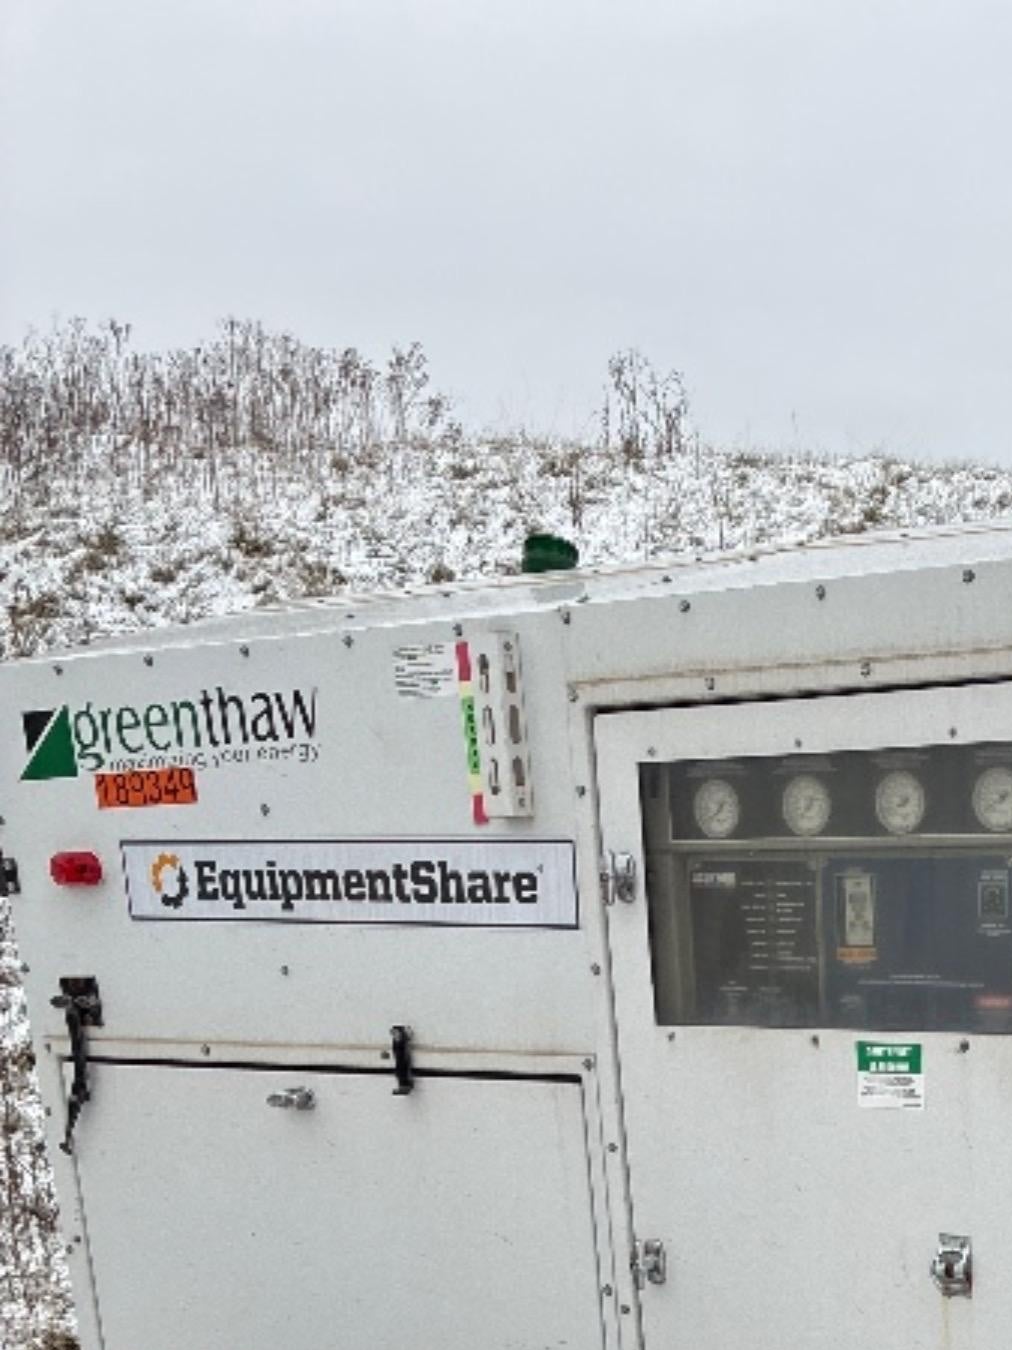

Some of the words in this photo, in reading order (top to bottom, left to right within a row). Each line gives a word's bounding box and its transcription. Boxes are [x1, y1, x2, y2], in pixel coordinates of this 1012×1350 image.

[73, 686, 318, 772] greenthaw
[256, 743, 322, 763] energy
[194, 859, 539, 910] EquipmentShare
